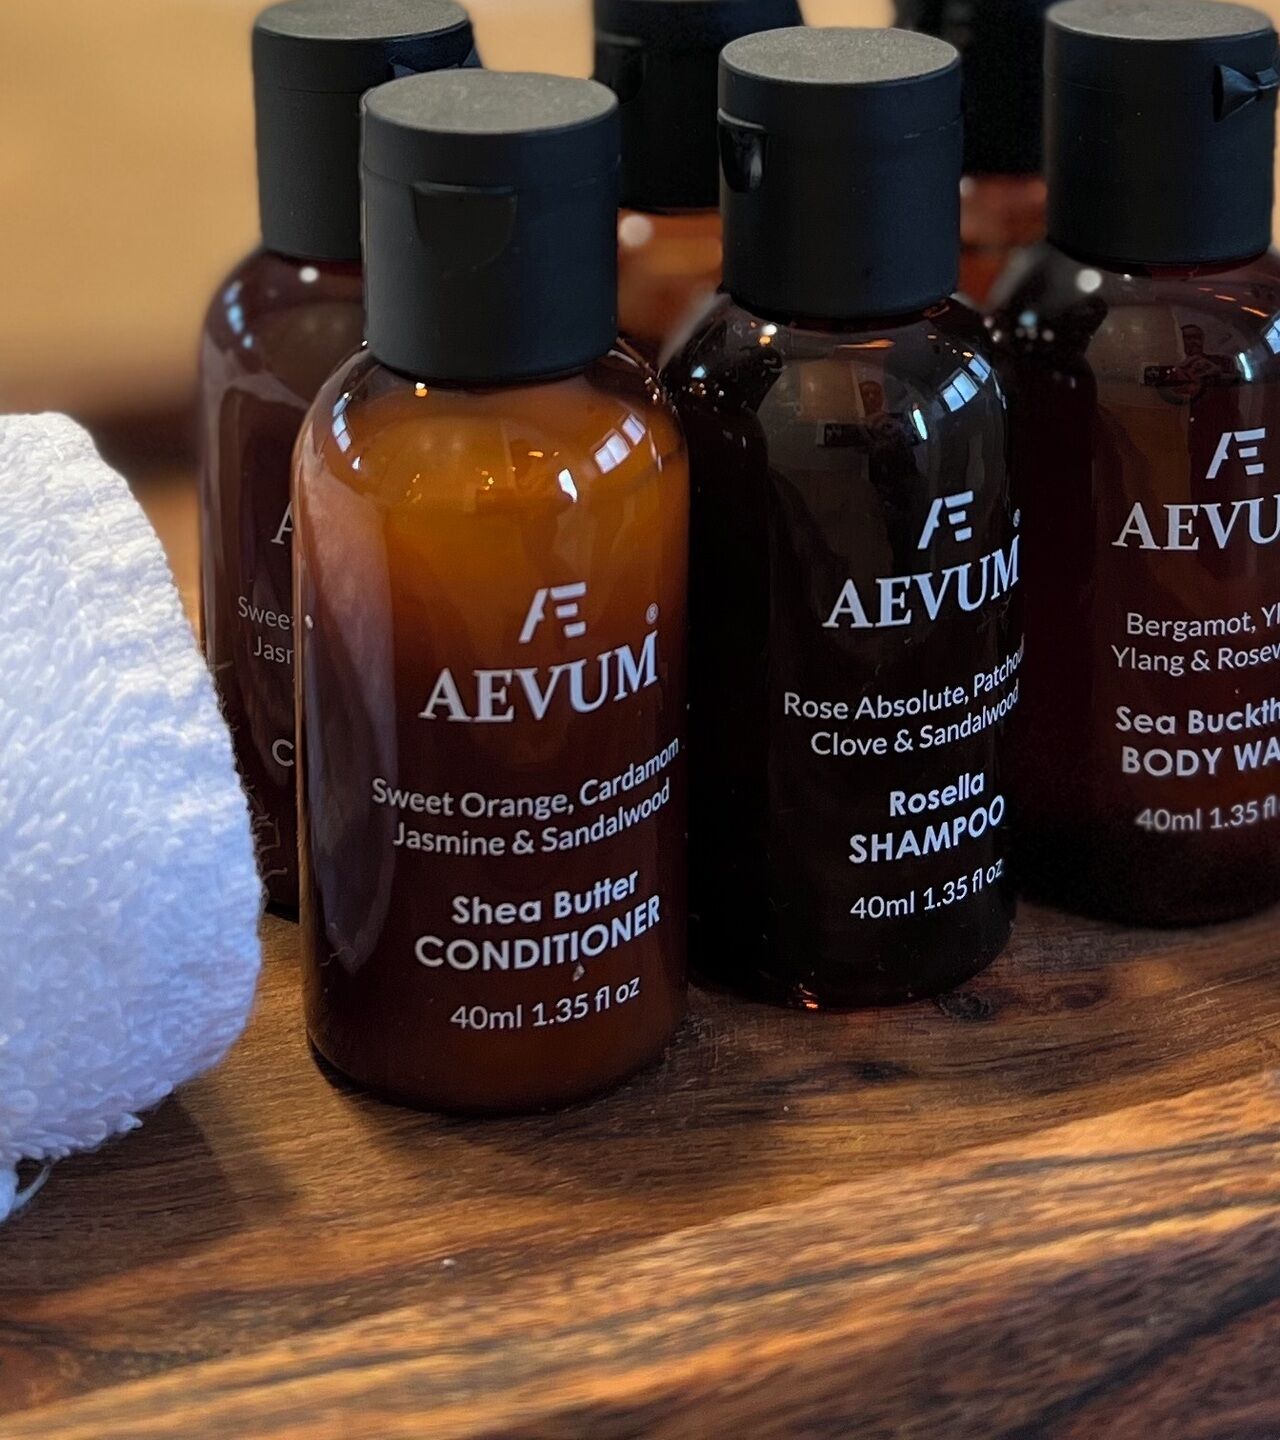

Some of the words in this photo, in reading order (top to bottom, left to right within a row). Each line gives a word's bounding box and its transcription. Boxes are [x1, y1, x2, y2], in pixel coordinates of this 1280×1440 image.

[822, 534, 1020, 628] AEVUM
[1126, 611, 1256, 642] Bergamot,
[418, 630, 658, 723] AEVUM
[1111, 644, 1185, 677] Ylang
[1190, 649, 1211, 671] &
[784, 691, 849, 720] Rose
[853, 686, 969, 721] Absolute,
[810, 731, 887, 757] Clove
[893, 728, 913, 753] &
[919, 677, 1020, 750] Sandalwood
[1115, 706, 1177, 735] Sea
[371, 777, 454, 817] Sweet
[460, 792, 574, 821] Orange,
[579, 737, 680, 807] Cardamom
[1122, 745, 1223, 777] BODY
[393, 821, 506, 857] Jasmine
[512, 829, 535, 855] &
[541, 776, 670, 853] Sandalwood
[889, 772, 985, 817] Rosella
[1135, 807, 1202, 832] 40ml
[1209, 800, 1258, 829] 1.35
[1262, 793, 1276, 820] fl
[848, 794, 1005, 864] SHAMPOO
[451, 895, 542, 926] Shea
[554, 870, 639, 920] Butter
[850, 890, 915, 919] 40ml
[923, 875, 968, 910] 1.35
[972, 867, 983, 894] fl
[986, 858, 1003, 884] oz
[415, 895, 661, 972] CONDITIONER
[450, 1004, 522, 1030] 40ml
[532, 993, 589, 1028] 1.35
[594, 985, 610, 1013] fl
[615, 976, 641, 1004] oz
